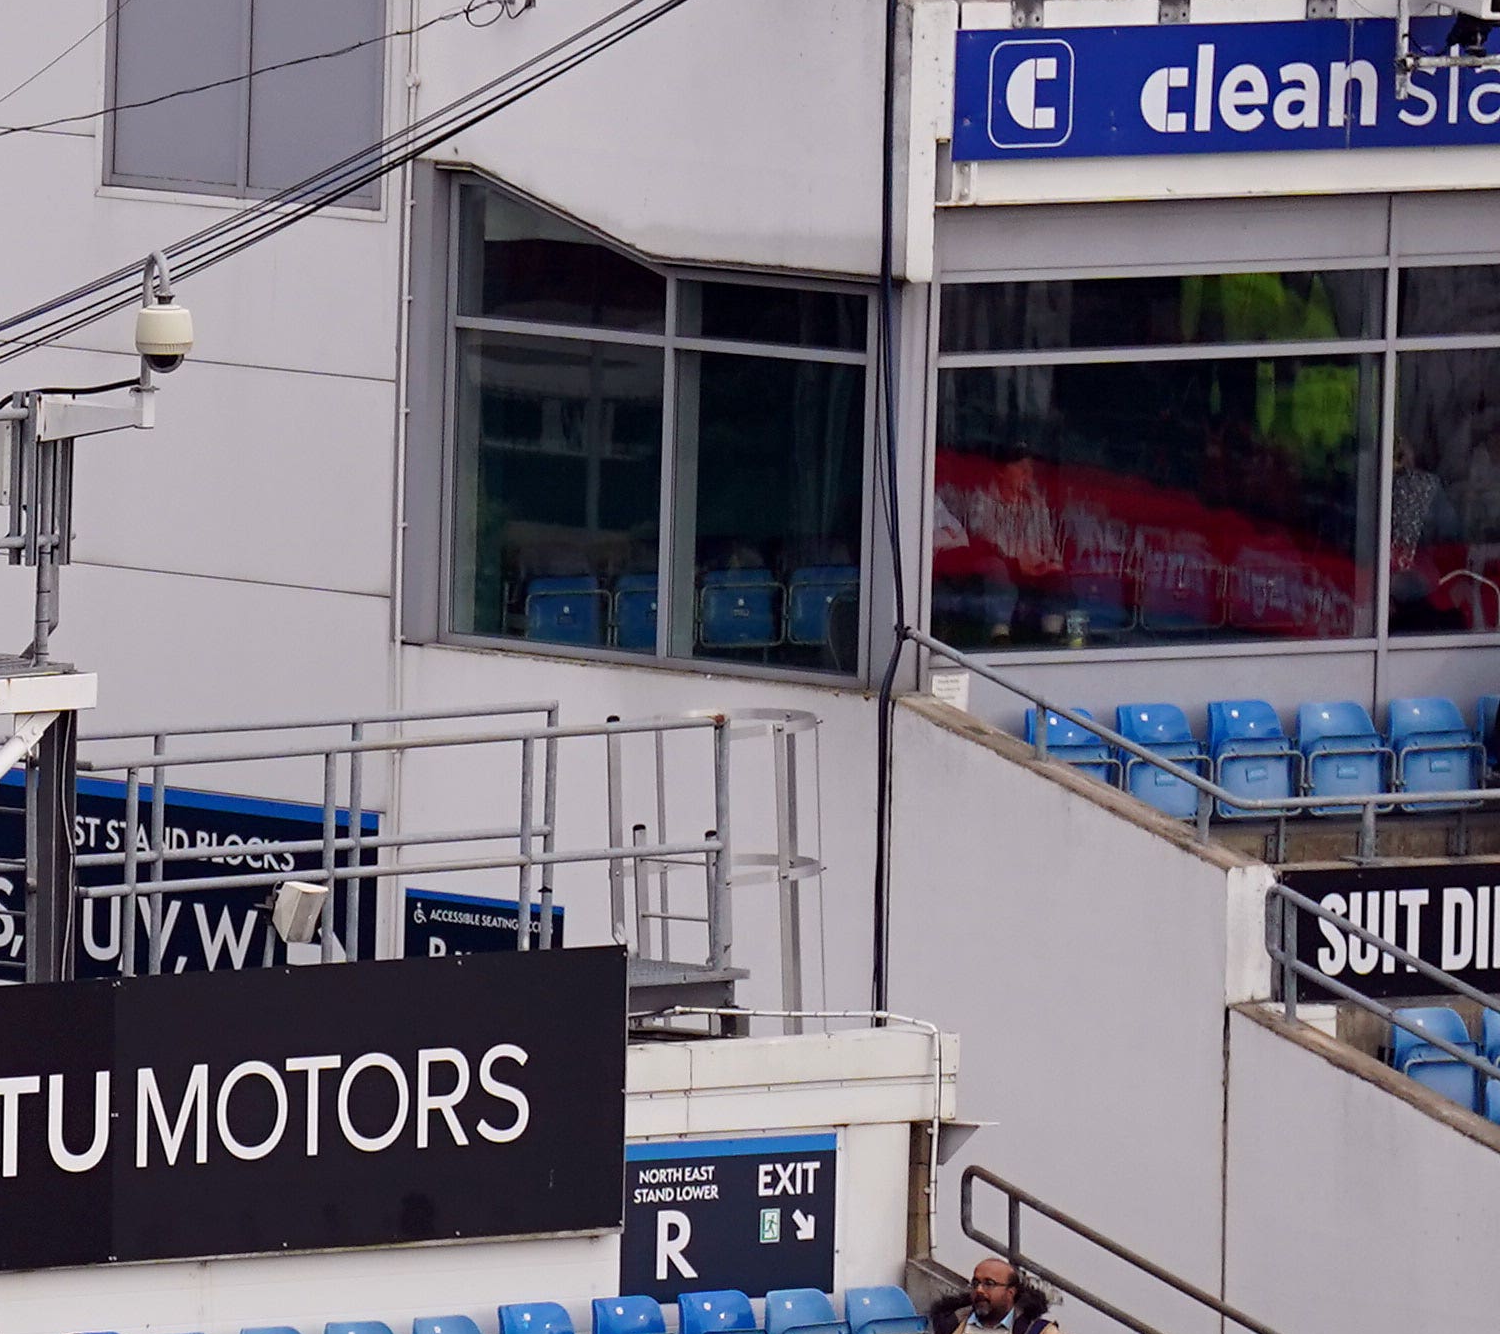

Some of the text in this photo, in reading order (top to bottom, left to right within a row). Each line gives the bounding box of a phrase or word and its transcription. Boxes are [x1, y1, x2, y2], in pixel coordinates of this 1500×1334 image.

[1141, 44, 1377, 132] clean
[429, 908, 480, 927] ACCESSIBLE
[480, 915, 520, 932] SEATING
[1317, 888, 1431, 977] SUIT
[137, 1044, 529, 1167] MOTORS
[634, 1185, 718, 1203] STAND LOWER
[639, 1166, 716, 1185] NORTH EAST
[759, 1162, 820, 1196] EXIT
[657, 1210, 698, 1279] R
